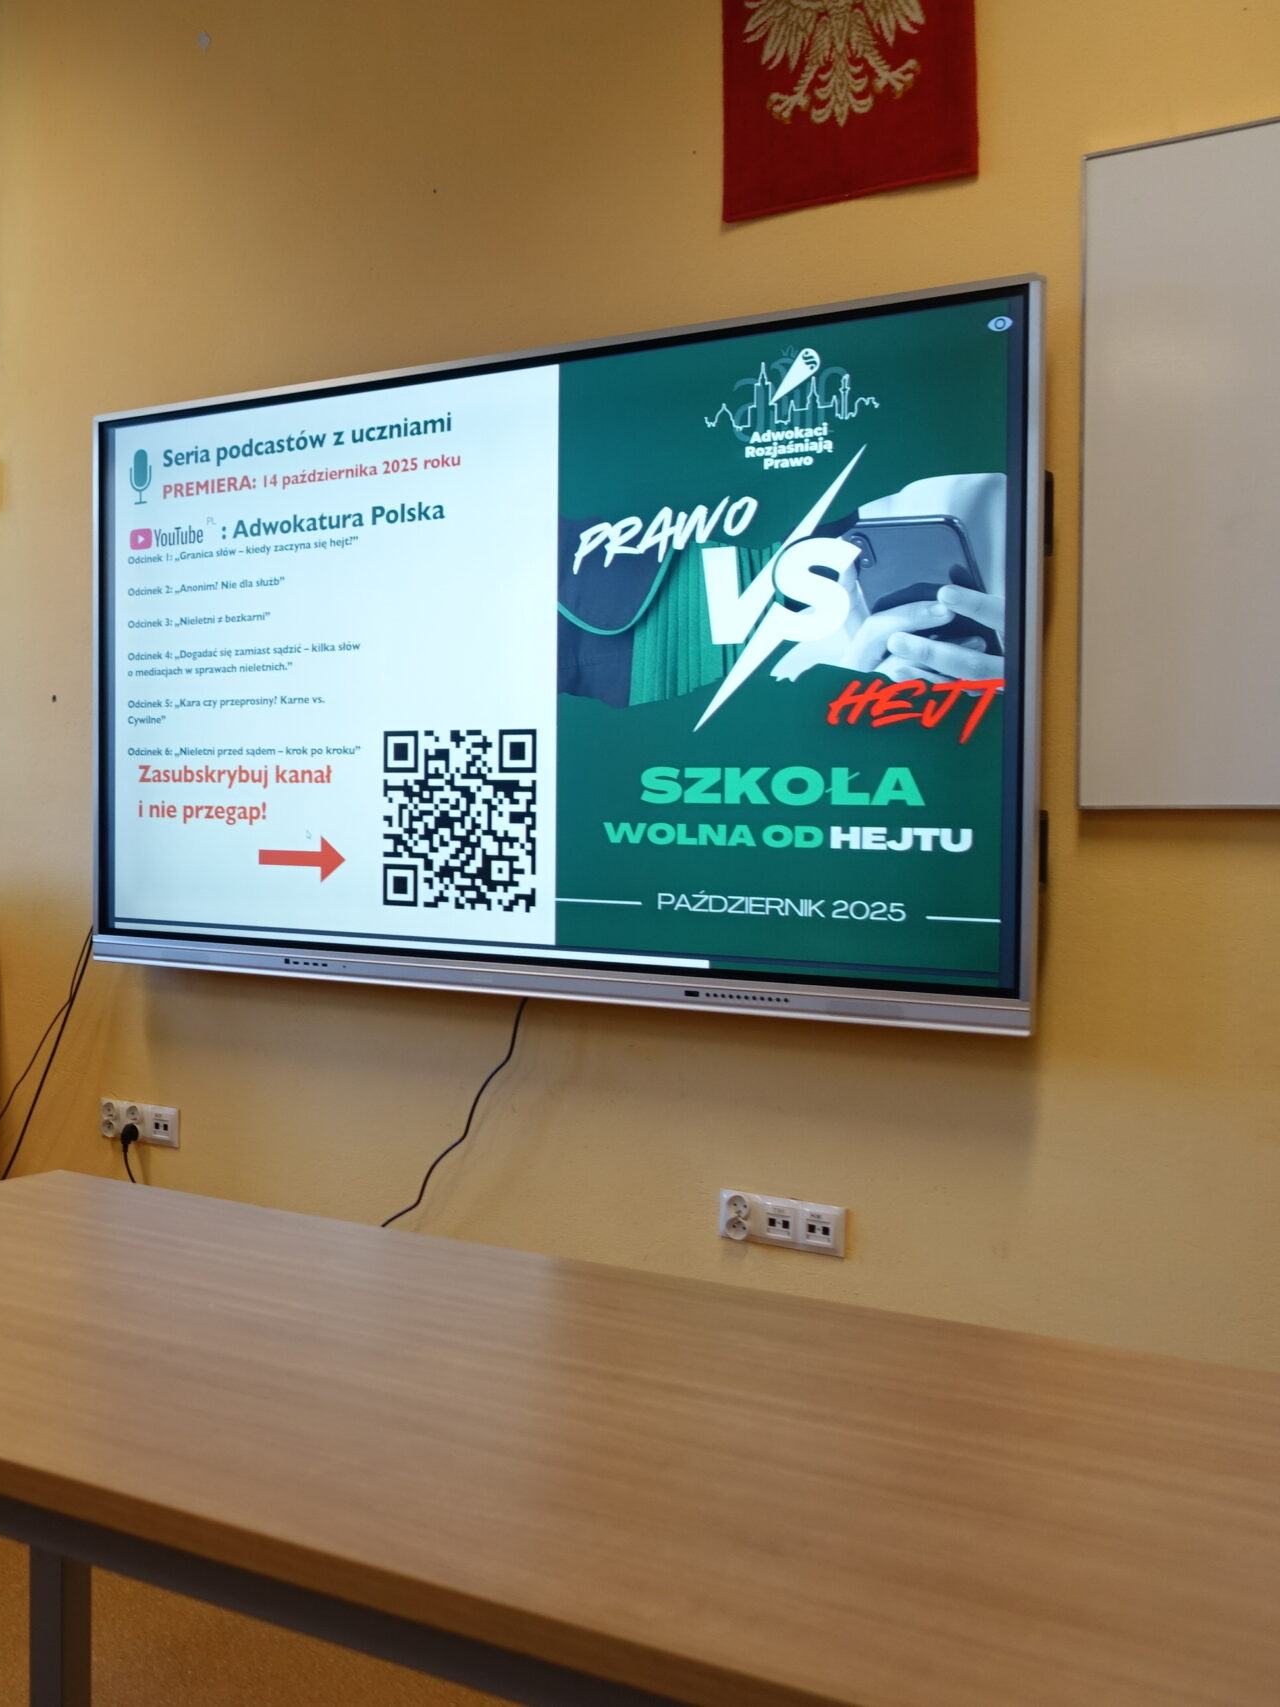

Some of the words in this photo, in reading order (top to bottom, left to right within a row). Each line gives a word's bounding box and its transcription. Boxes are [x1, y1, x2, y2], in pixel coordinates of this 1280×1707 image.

[163, 446, 211, 468] Seria
[216, 430, 326, 467] podcastów
[333, 431, 345, 446] z
[351, 411, 452, 443] uczniami
[749, 422, 829, 444] Adwokaci
[744, 437, 833, 459] Rozjaśniają
[763, 455, 814, 470] Prawo
[163, 475, 257, 499] PREMIERA:
[263, 473, 278, 488] 14
[282, 463, 377, 490] października
[382, 457, 418, 475] 2025
[423, 454, 461, 470] roku
[153, 525, 204, 547] YouTube
[232, 513, 365, 539] Adwokatura
[371, 502, 445, 525] Polska
[573, 496, 758, 574] PRAWO
[127, 553, 163, 565] Odcinek
[216, 547, 236, 557] słów
[246, 545, 271, 556] kiedy
[274, 541, 311, 552] zaczyna
[314, 539, 327, 550] się
[127, 585, 163, 597] Odcinek
[165, 585, 173, 595] 2:
[221, 580, 237, 590] Nie
[239, 579, 253, 589] dla
[701, 537, 862, 645] VS
[127, 618, 163, 629] Odcinek
[165, 617, 173, 627] 3:
[127, 651, 163, 661] Odcinek
[165, 651, 173, 660] 4:
[220, 647, 232, 658] się
[234, 646, 271, 656] zamiast
[273, 643, 302, 656] sądzić
[311, 643, 336, 653] kilka
[338, 641, 361, 652] słów
[127, 670, 134, 678] o
[135, 666, 183, 678] mediacjach
[185, 667, 193, 676] w
[195, 664, 237, 677] sprawach
[127, 699, 163, 709] Odcinek
[165, 698, 173, 708] 5:
[203, 699, 217, 709] czy
[280, 695, 310, 705] Karne
[312, 696, 326, 704] vs.
[827, 678, 1006, 744] HEJT
[127, 747, 163, 757] Odcinek
[165, 747, 173, 756] 6:
[217, 746, 243, 758] przed
[246, 746, 276, 758] sądem
[285, 745, 308, 756] krok
[311, 747, 323, 758] po
[138, 765, 269, 789] Zasubskrybuj
[275, 765, 333, 784] kanał
[640, 766, 926, 806] SZKOŁA
[138, 800, 144, 818] i
[149, 800, 177, 818] nie
[182, 802, 267, 825] przegap!
[603, 821, 757, 848] WOLNA
[762, 824, 824, 849] OD
[830, 825, 973, 853] HEJTU
[657, 890, 824, 919] PAŹDZIERNIK
[831, 899, 907, 923] 2025
